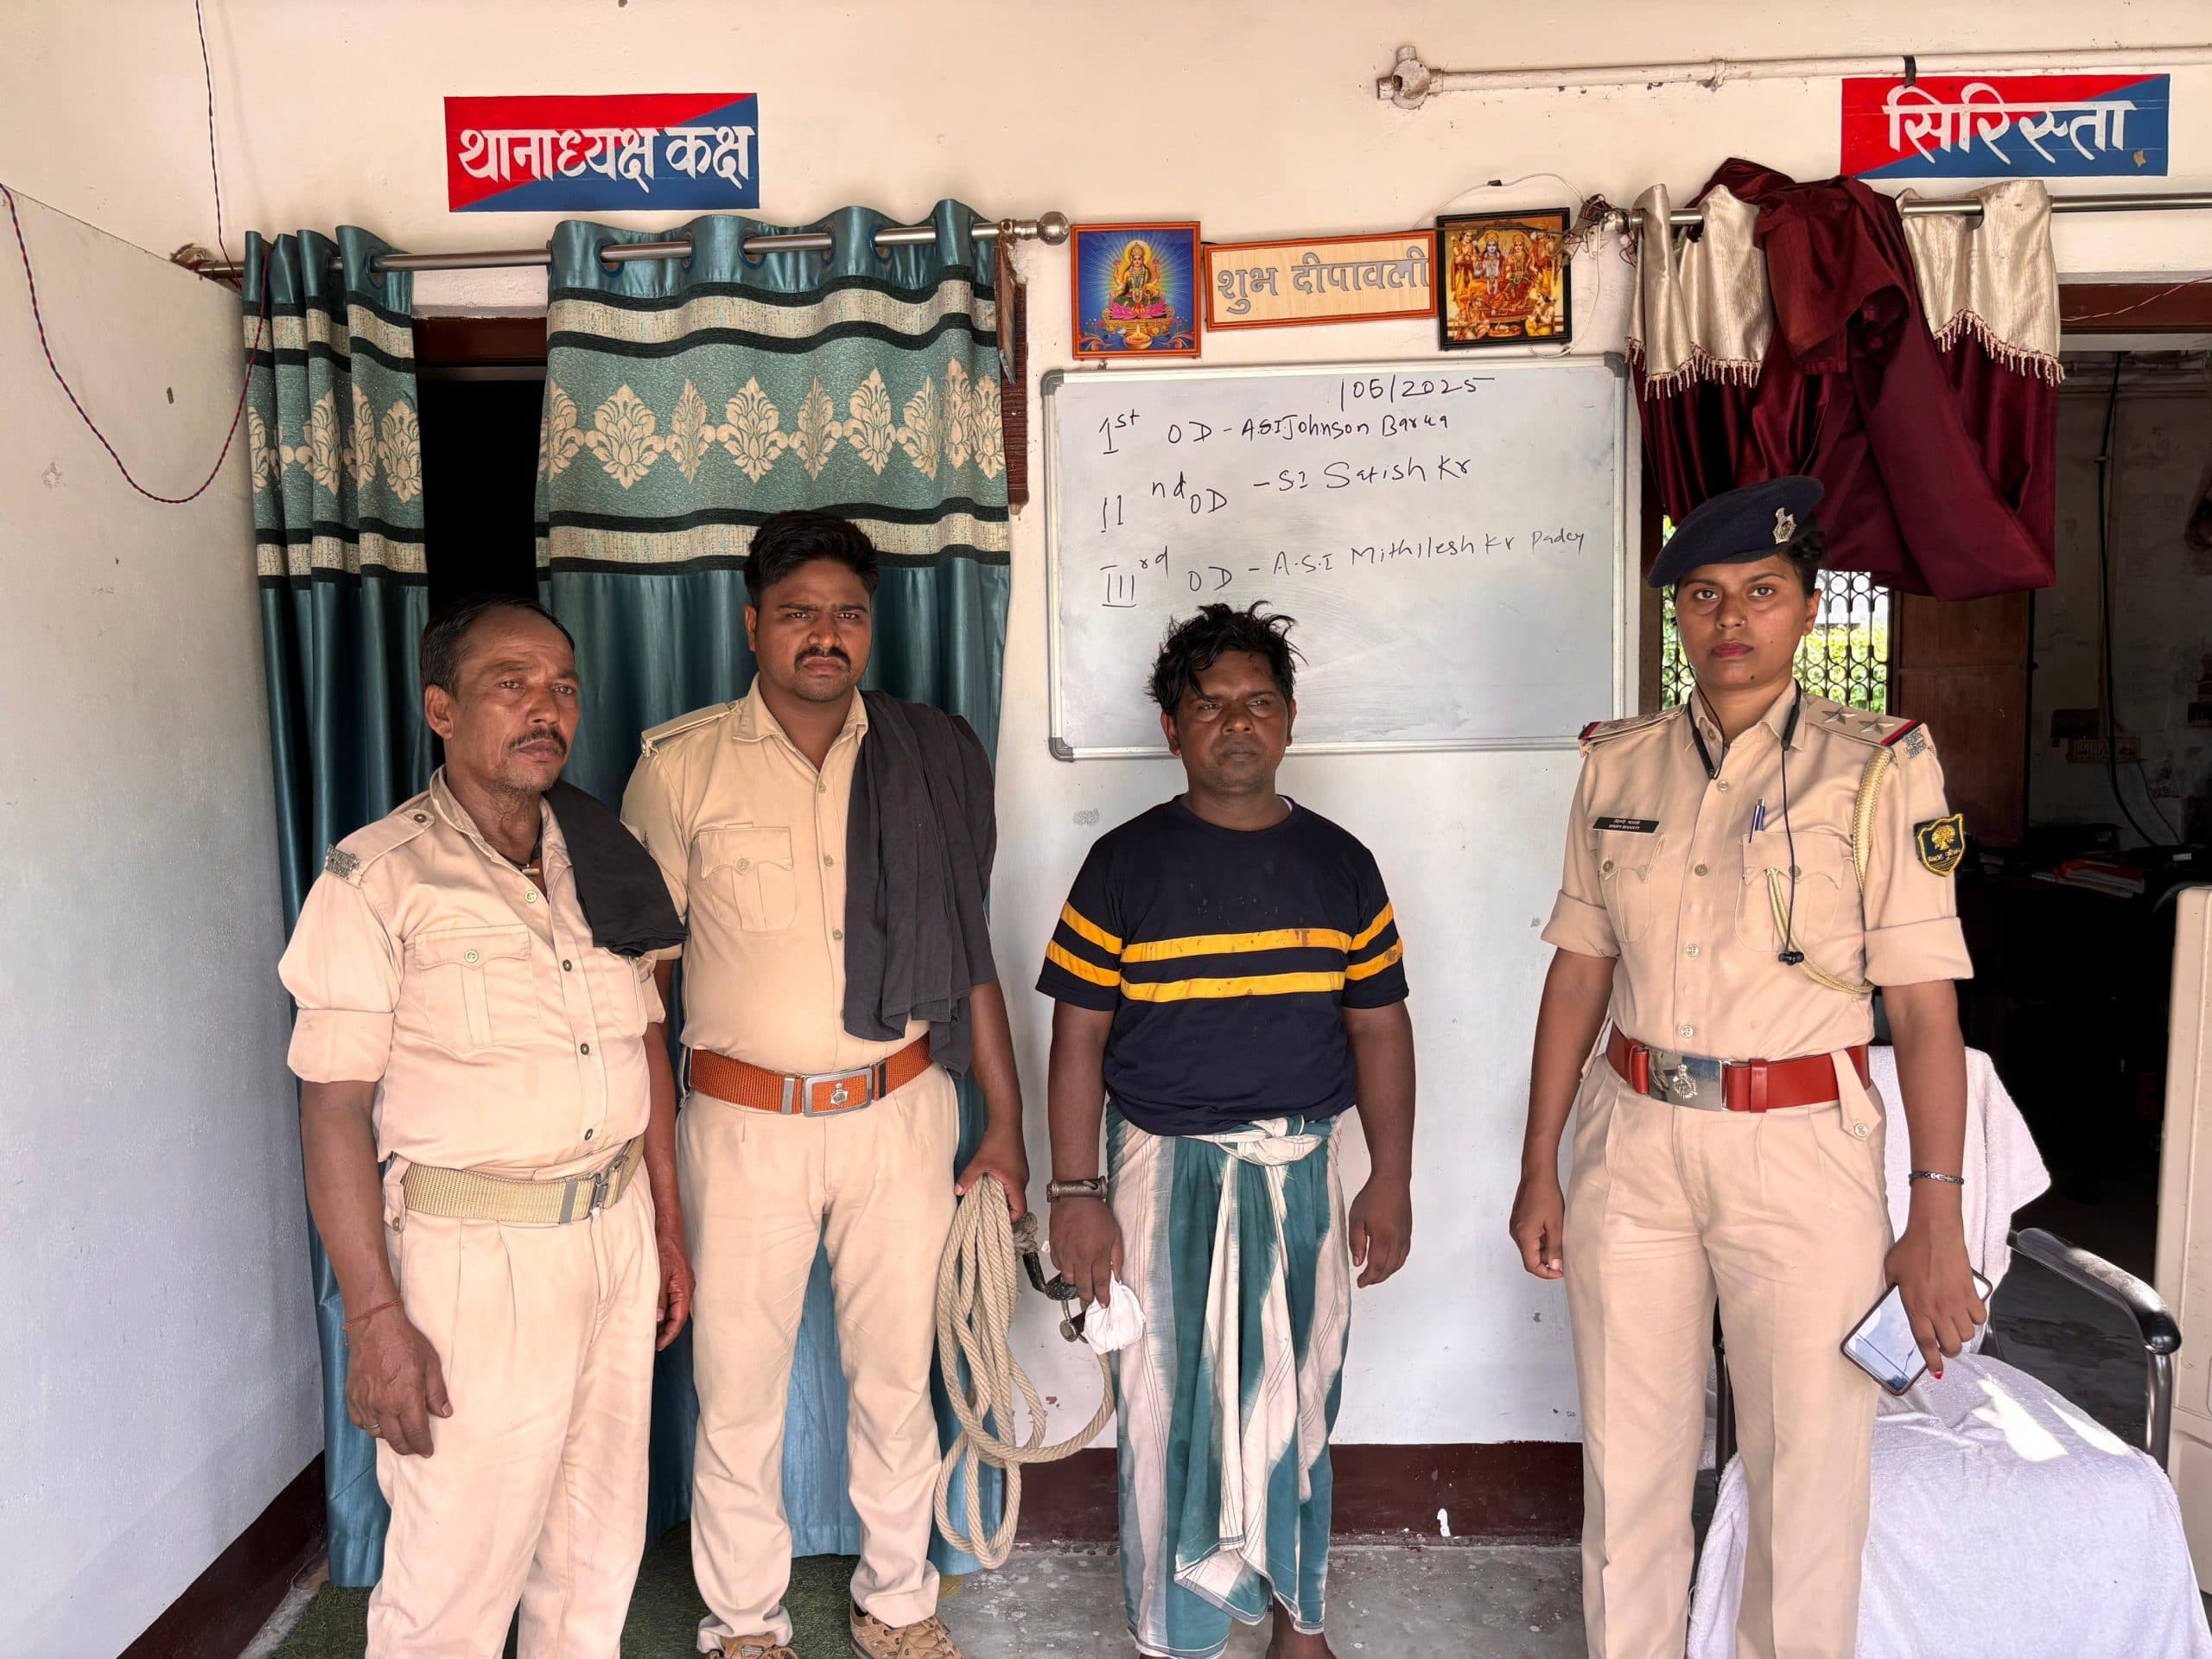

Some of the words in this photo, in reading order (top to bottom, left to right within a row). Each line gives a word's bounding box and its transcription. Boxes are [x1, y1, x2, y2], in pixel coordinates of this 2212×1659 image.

[1881, 82, 2139, 165] सिरिस्ता
[458, 126, 659, 193] थानाध्यक्ष
[664, 126, 755, 189] कक्ष
[1217, 266, 1280, 315] शुभ
[1292, 245, 1430, 295] दीपावली
[1324, 456, 1427, 489] Satish
